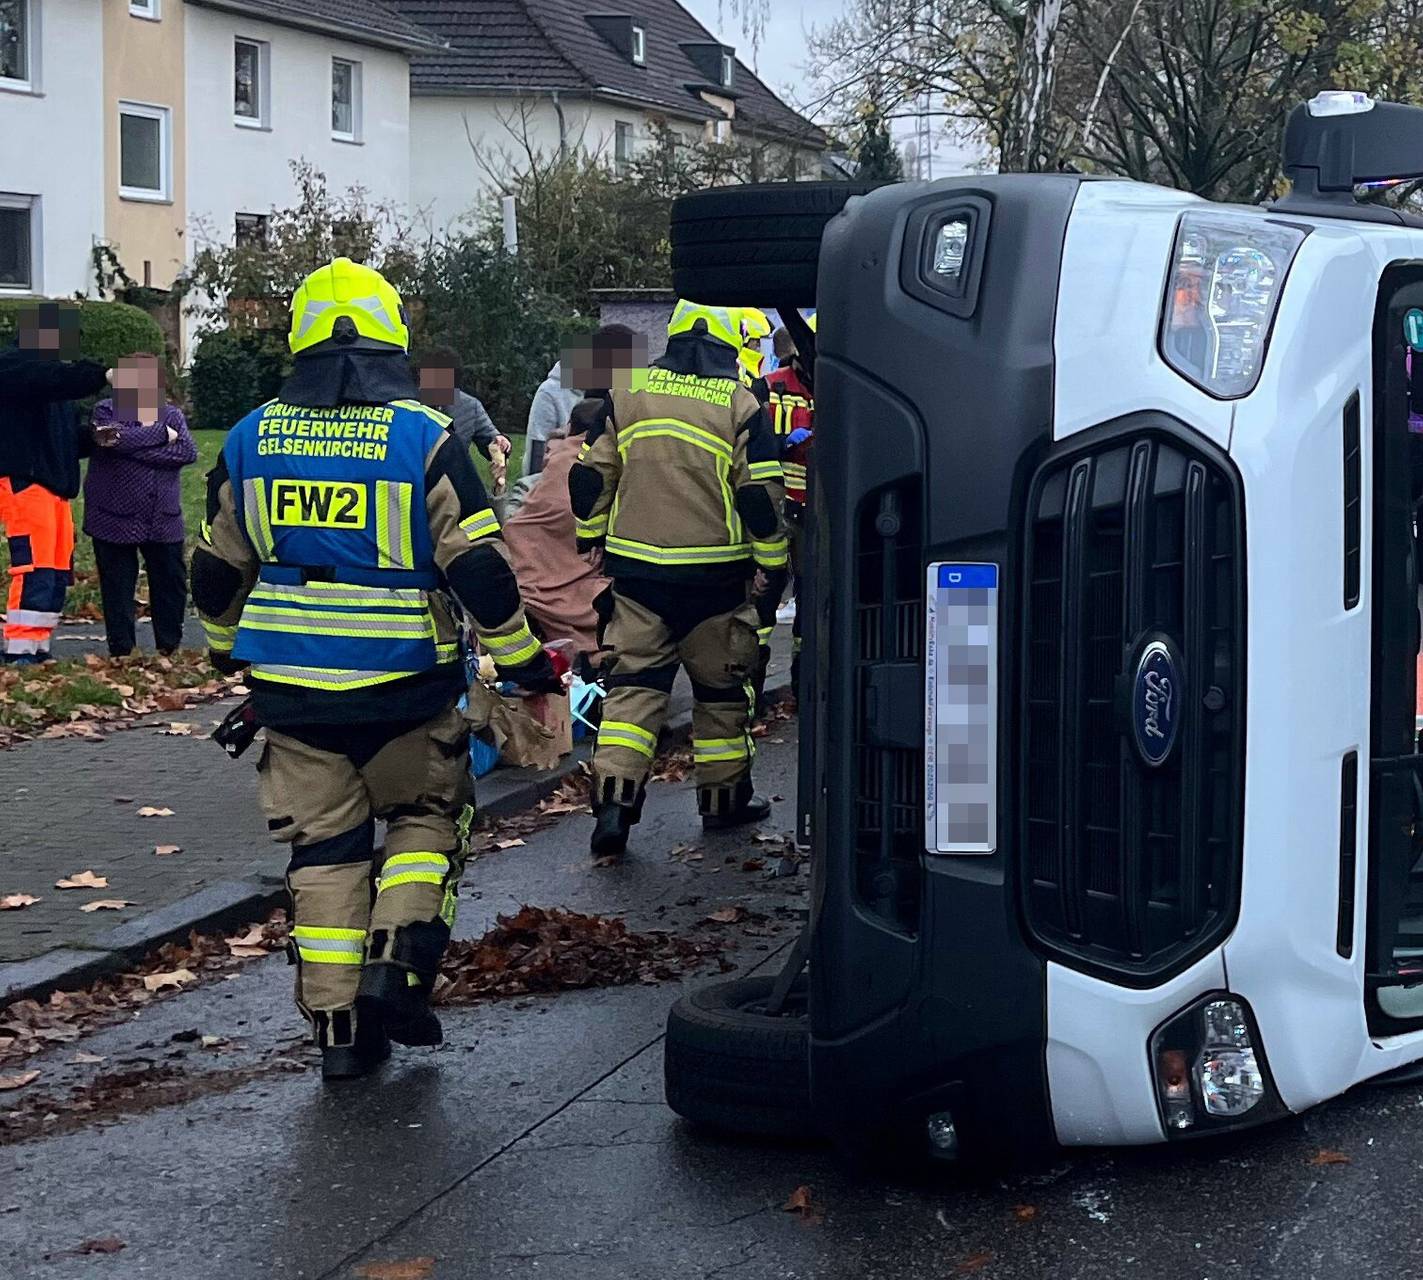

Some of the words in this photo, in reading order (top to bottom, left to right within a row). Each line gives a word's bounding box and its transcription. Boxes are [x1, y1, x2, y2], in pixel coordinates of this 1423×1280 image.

[258, 419, 389, 441] FEUERWEHR
[257, 437, 387, 461] GELSENKIRCHEN
[277, 485, 359, 523] FW2
[949, 573, 961, 582] D
[1144, 671, 1172, 738] Ford
